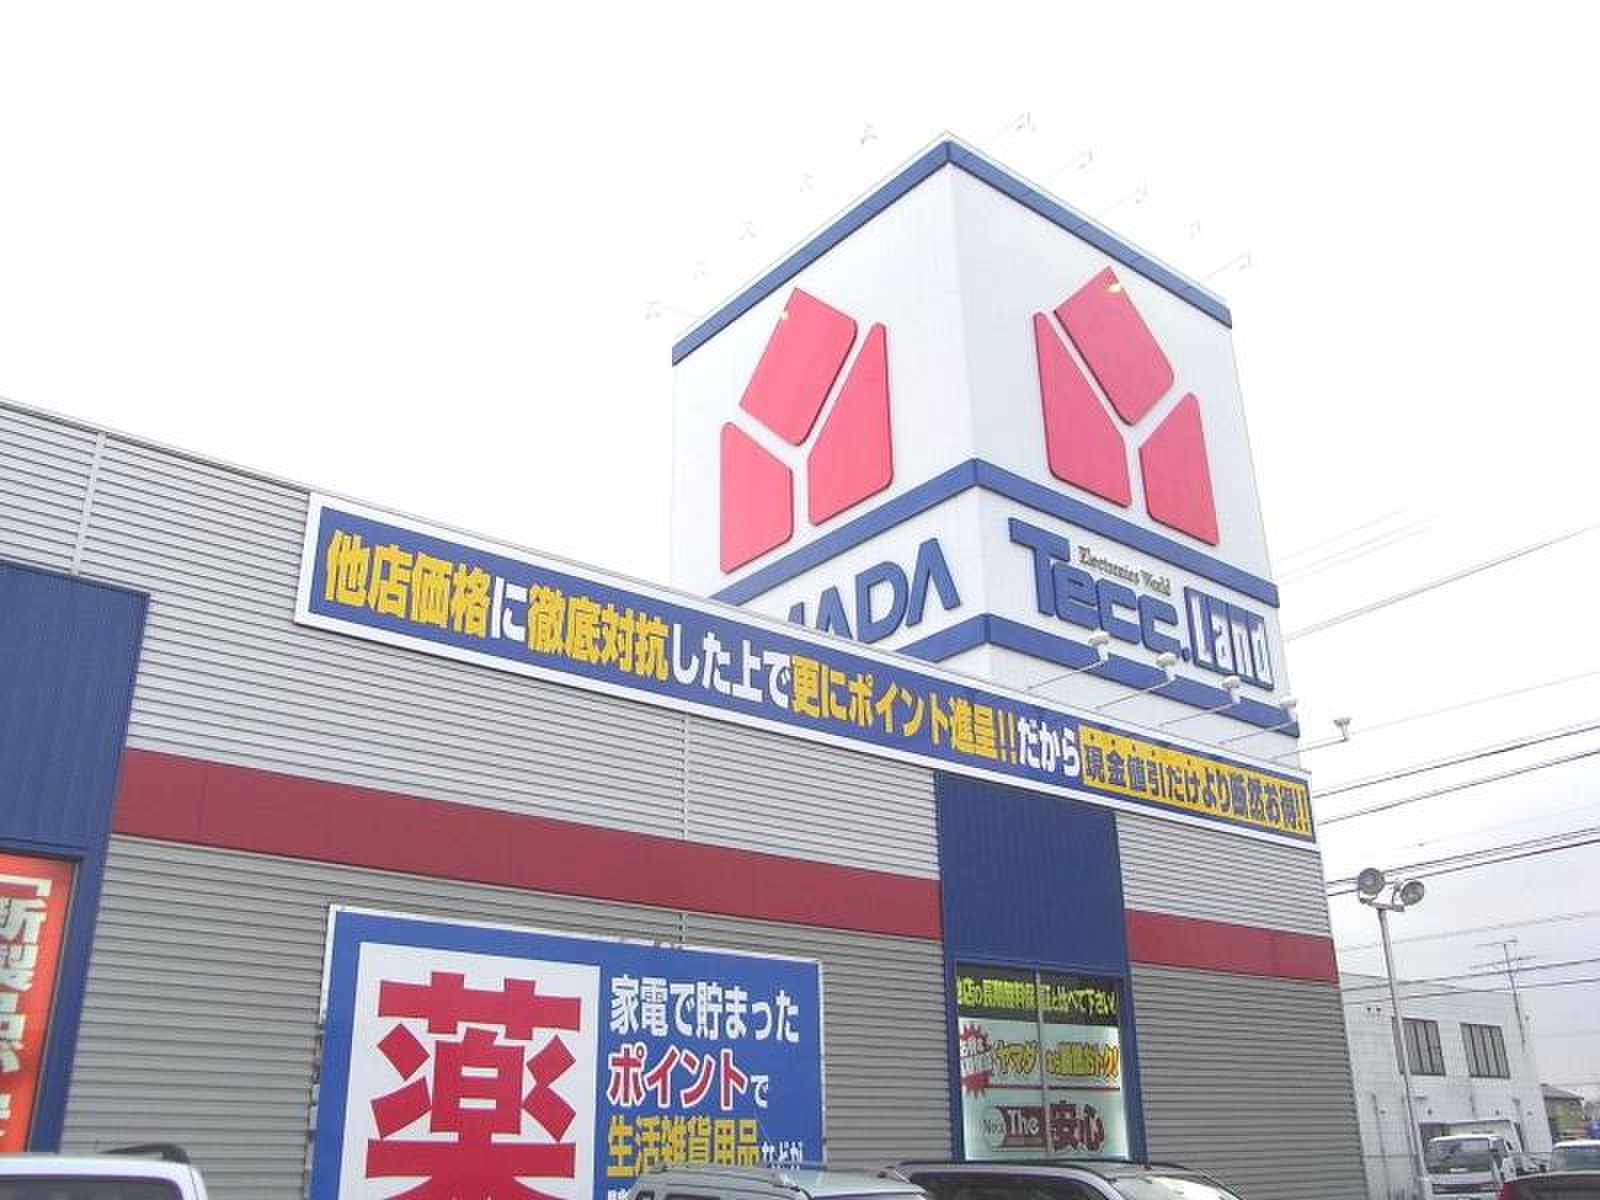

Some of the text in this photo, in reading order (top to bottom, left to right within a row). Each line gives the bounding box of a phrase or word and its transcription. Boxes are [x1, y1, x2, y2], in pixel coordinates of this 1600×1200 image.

[1078, 545, 1171, 597] Electronics World
[609, 973, 800, 1043] 家電で貯まった
[366, 971, 581, 1200] 薬
[606, 1041, 769, 1111] ポイントで
